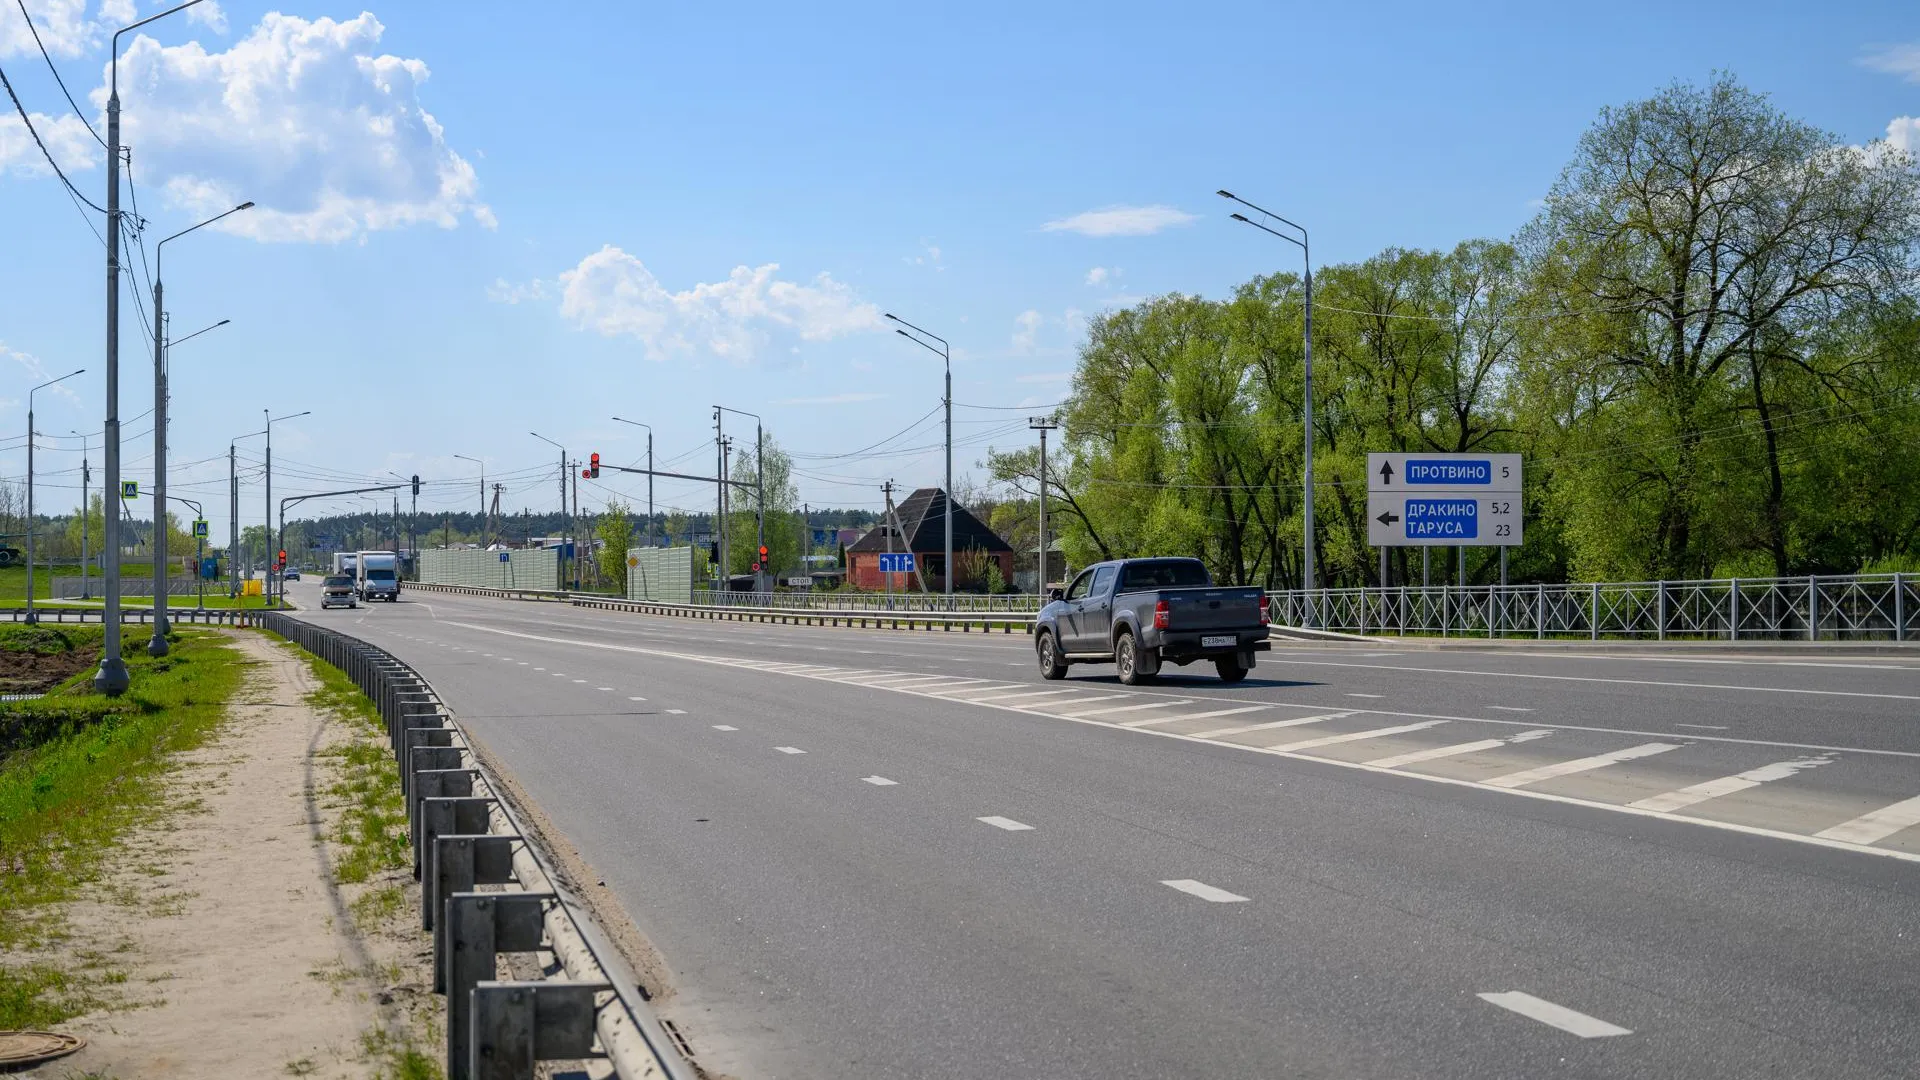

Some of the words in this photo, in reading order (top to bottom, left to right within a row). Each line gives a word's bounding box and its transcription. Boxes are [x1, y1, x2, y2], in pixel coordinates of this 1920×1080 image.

[1411, 466, 1486, 479] ПРОТВИНО
[1502, 466, 1510, 478] 5
[1408, 503, 1475, 518] ДРАКИНО
[1491, 502, 1510, 515] 5,2
[1408, 521, 1464, 534] ТАРУСА
[1495, 524, 1511, 537] 23
